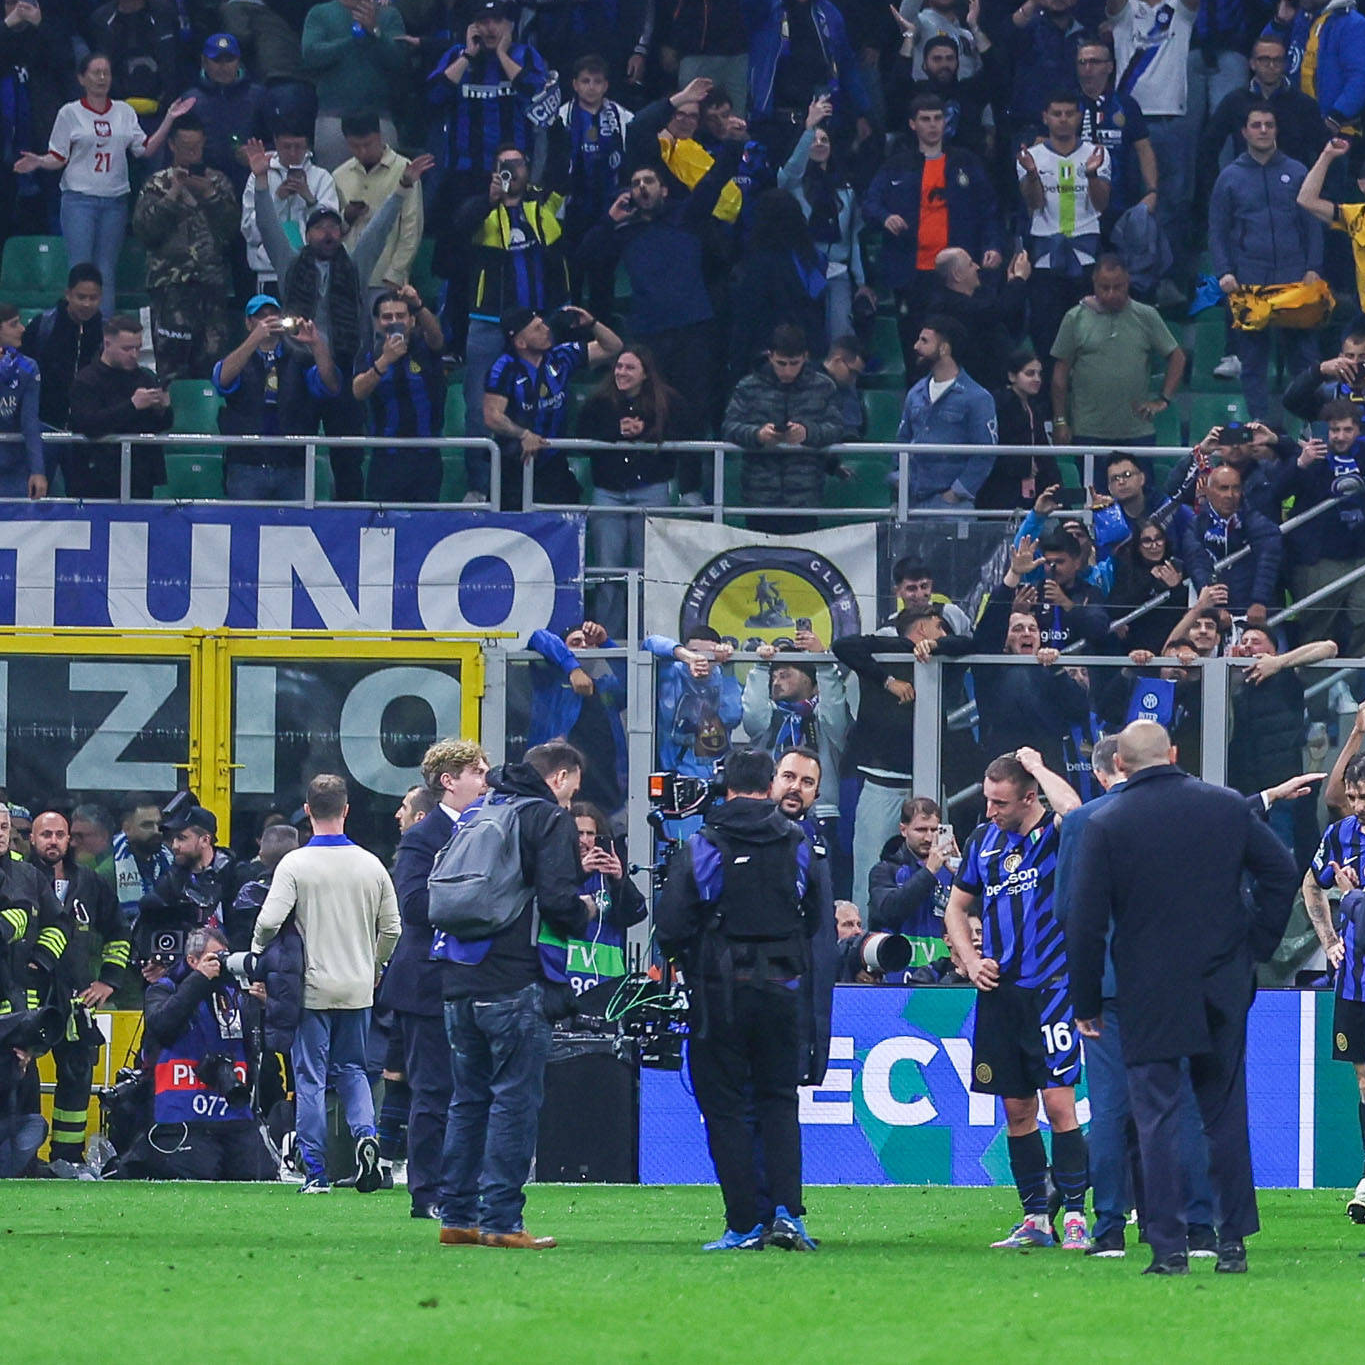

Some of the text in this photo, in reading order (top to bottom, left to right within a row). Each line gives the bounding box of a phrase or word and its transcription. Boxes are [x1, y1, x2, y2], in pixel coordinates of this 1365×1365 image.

[94, 151, 112, 173] 21
[0, 520, 559, 630] TUNO
[687, 559, 852, 612] INTER CLUB
[567, 943, 598, 970] TV
[1040, 1020, 1073, 1055] 16
[192, 1094, 230, 1117] 077
